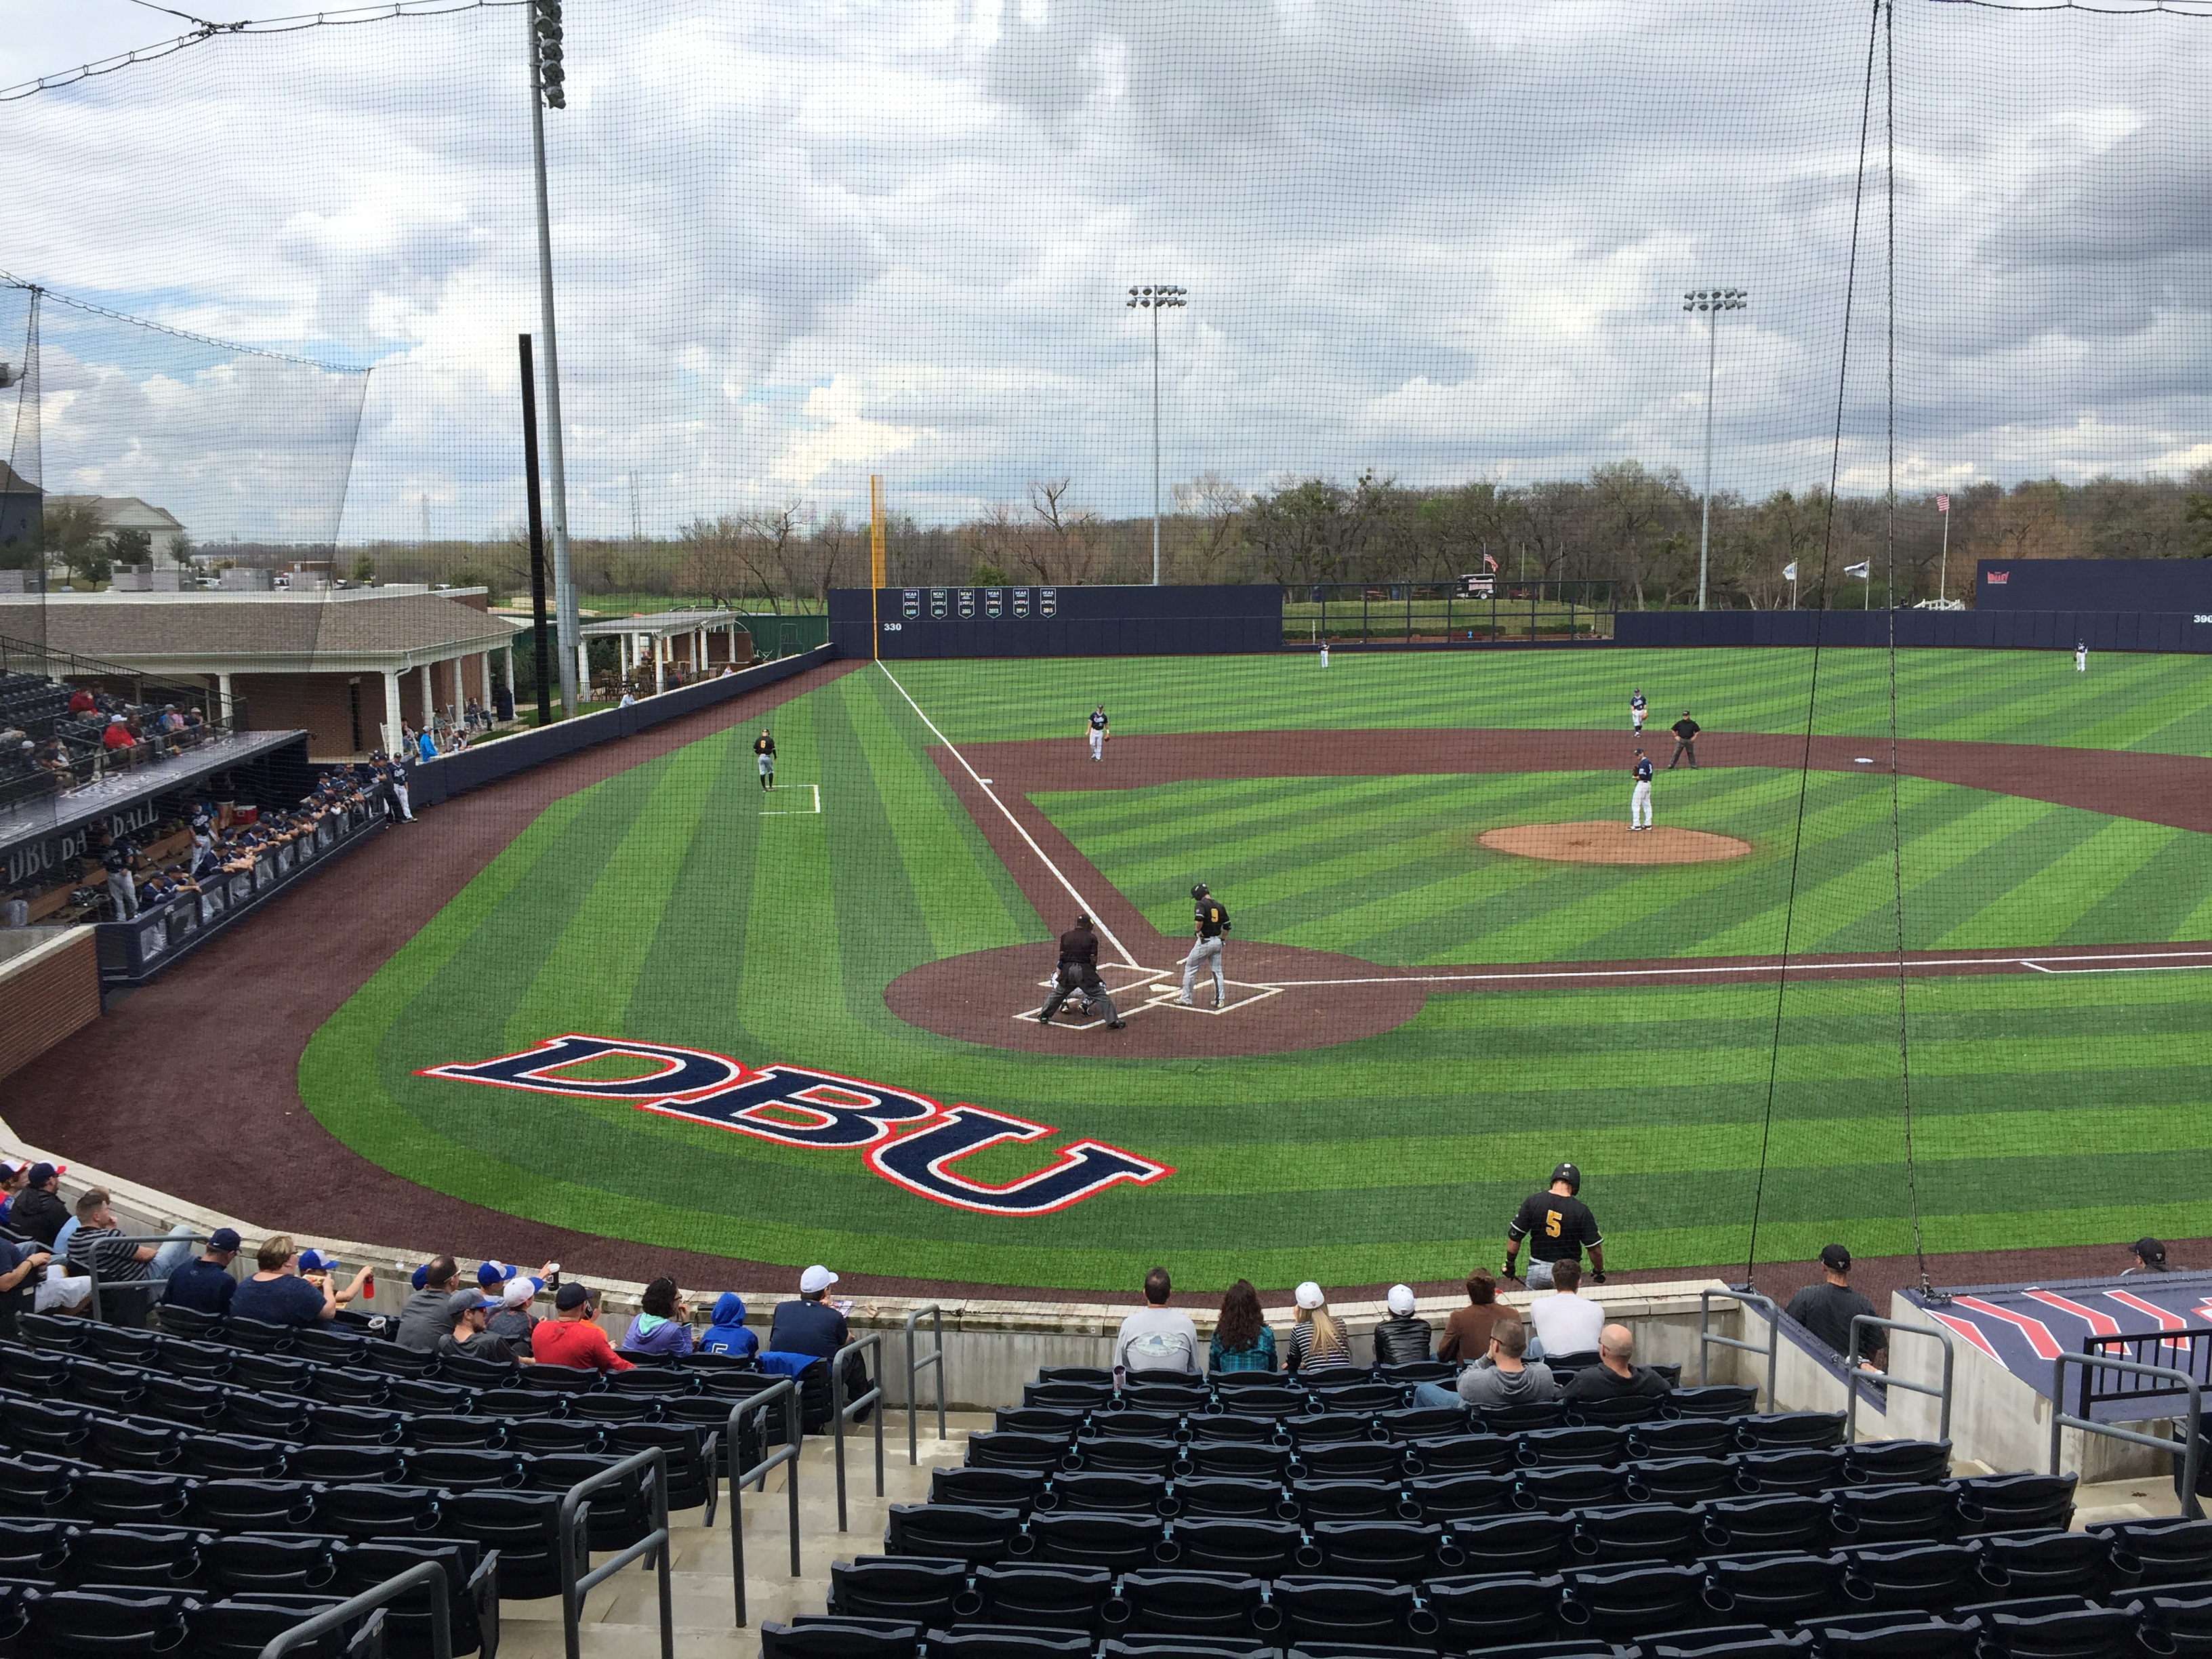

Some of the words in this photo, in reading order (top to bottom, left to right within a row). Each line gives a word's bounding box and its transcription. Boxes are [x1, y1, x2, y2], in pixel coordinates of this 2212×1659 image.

[2194, 615, 2212, 623] 390
[884, 623, 902, 631] 330
[760, 739, 766, 749] 6
[1210, 908, 1218, 923] 9
[410, 1033, 1174, 1216] DBU
[1545, 1209, 1563, 1238] 5
